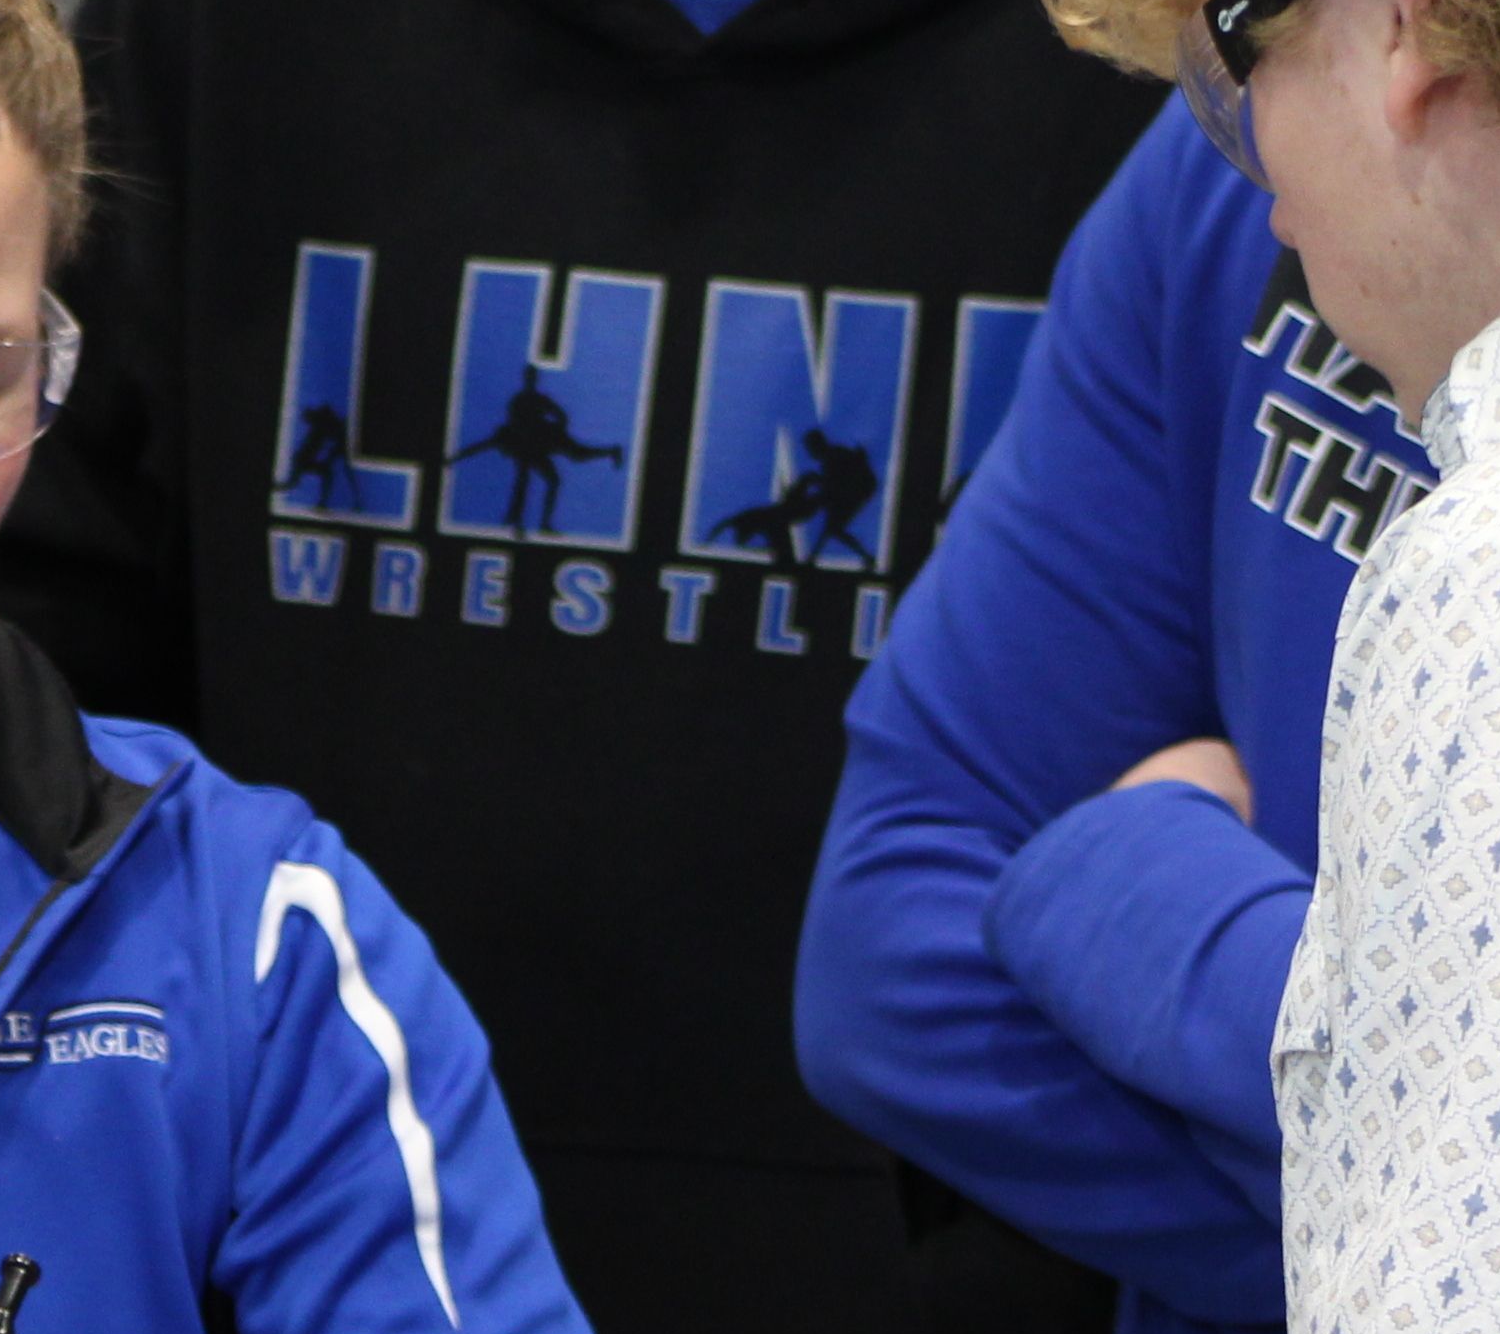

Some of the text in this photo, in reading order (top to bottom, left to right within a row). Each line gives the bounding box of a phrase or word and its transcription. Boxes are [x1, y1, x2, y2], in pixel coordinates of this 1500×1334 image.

[1250, 394, 1441, 566] TH
[268, 528, 890, 661] WRESTLI
[45, 1023, 167, 1064] EAGLES
